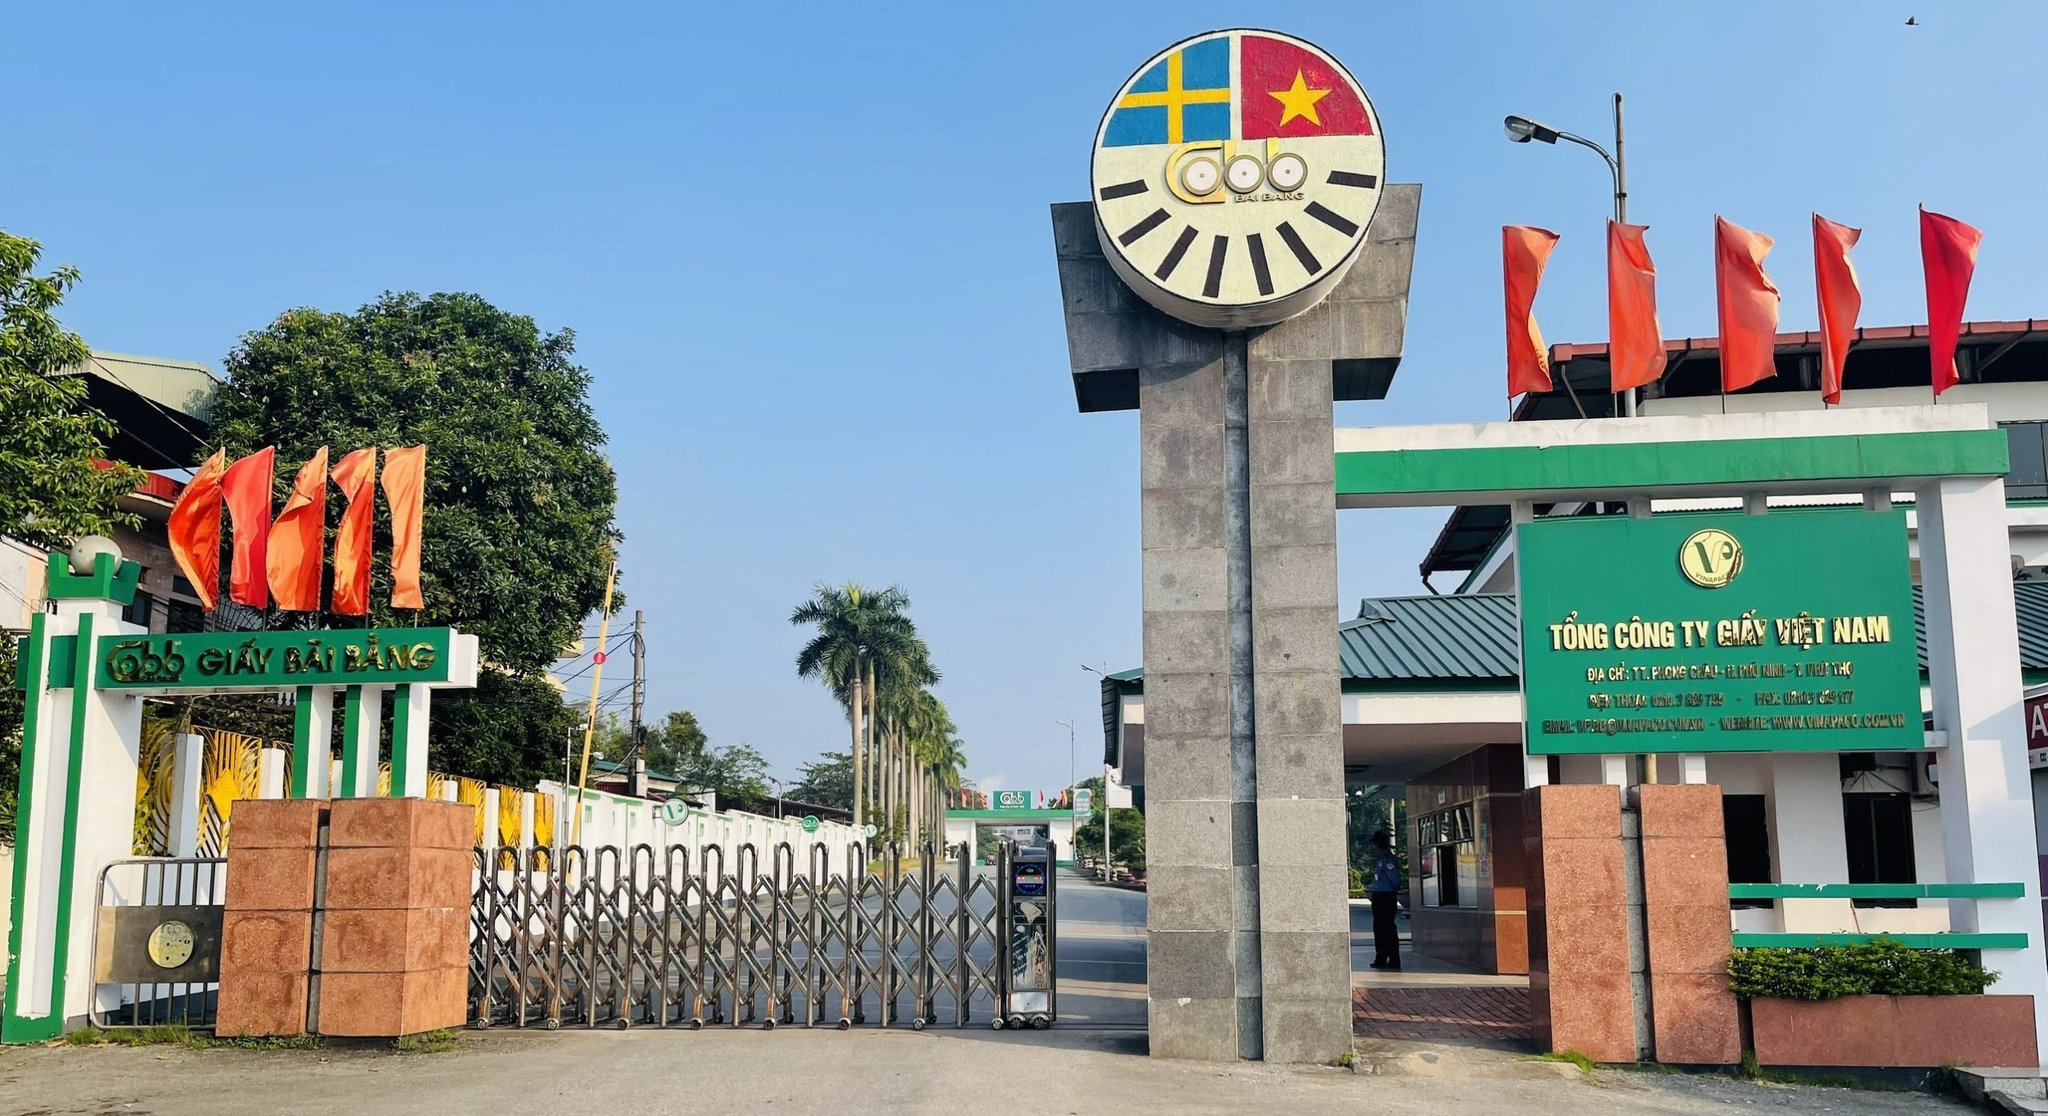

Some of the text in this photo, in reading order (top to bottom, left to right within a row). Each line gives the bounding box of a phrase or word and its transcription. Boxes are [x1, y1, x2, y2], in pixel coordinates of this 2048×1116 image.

[1235, 191, 1305, 203] BAI BANG
[1548, 608, 1891, 650] TỔNG CÔNG TY GIẤY VIỆT NAM
[196, 637, 274, 677] GIẤY
[285, 638, 337, 674] BÃI
[342, 631, 435, 673] BẰNG
[1587, 667, 1605, 684] ĐỊA
[1608, 661, 1630, 681] CHỈ:
[1831, 661, 1854, 678] THỌ
[2031, 702, 2048, 739] A
